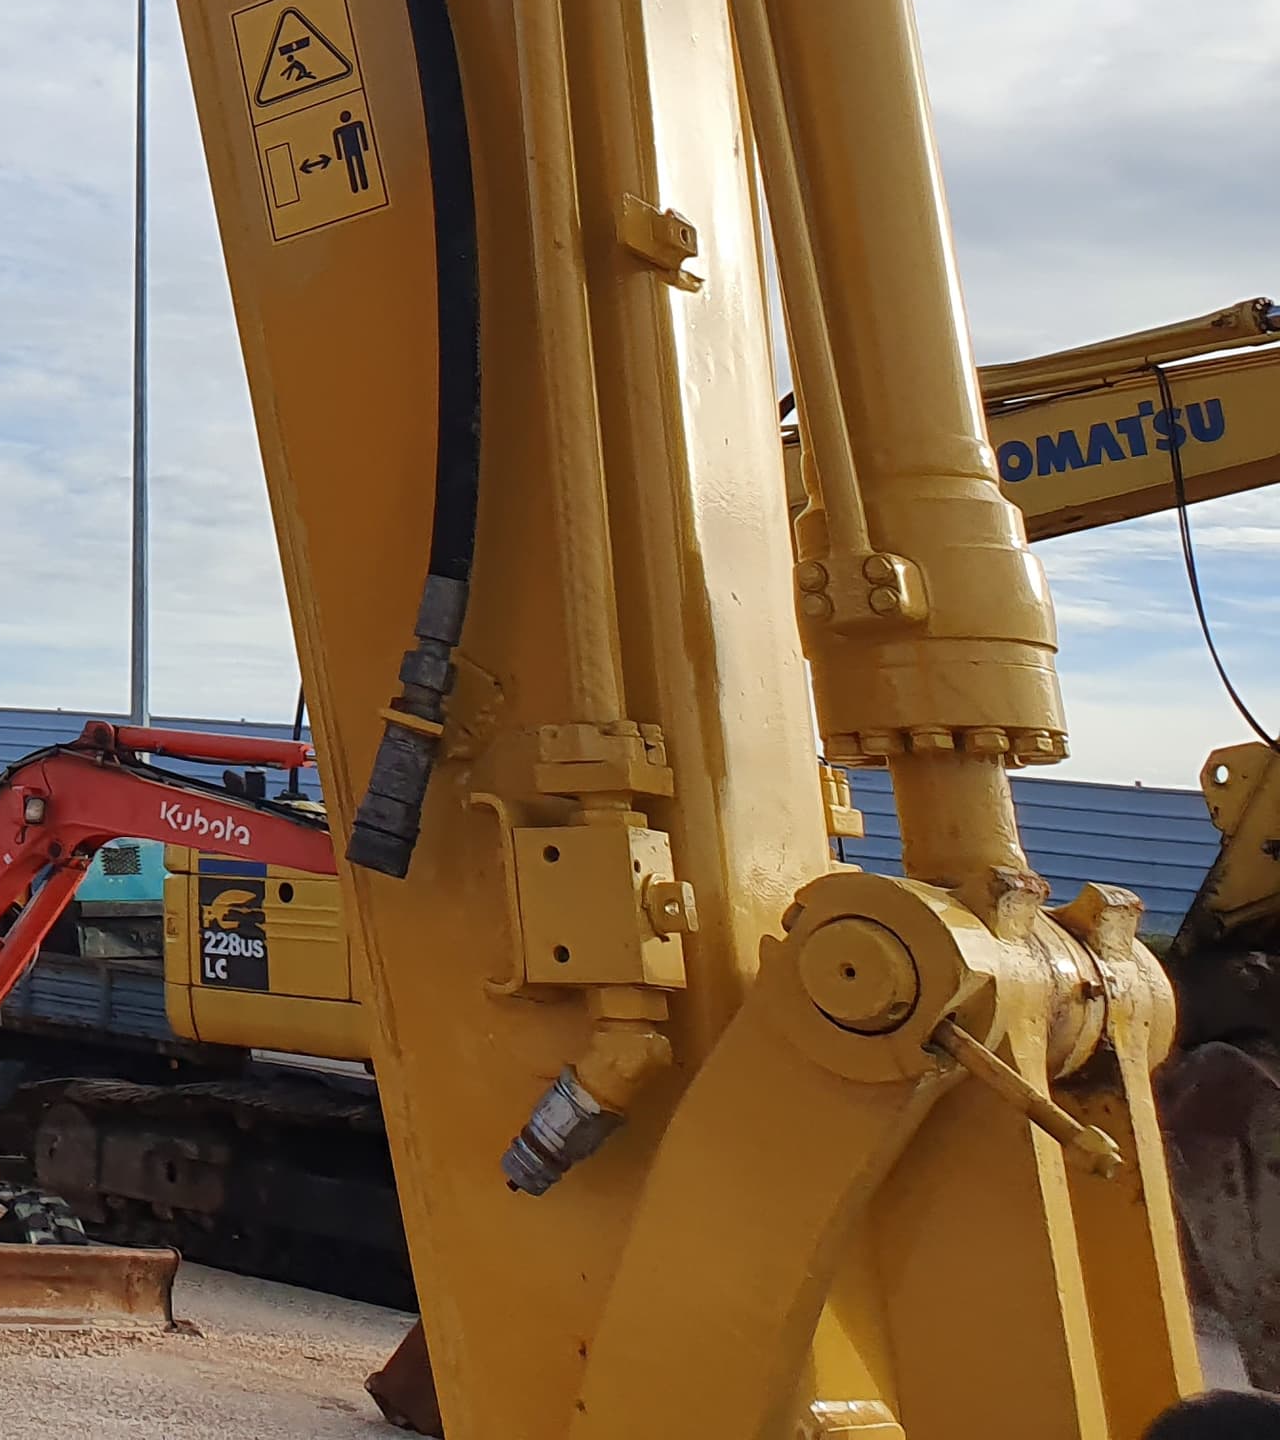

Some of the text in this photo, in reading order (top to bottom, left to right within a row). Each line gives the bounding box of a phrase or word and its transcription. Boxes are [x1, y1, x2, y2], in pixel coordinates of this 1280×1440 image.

[998, 400, 1225, 482] OMATSU
[160, 801, 250, 845] Kubota
[203, 931, 265, 958] 228US
[205, 958, 228, 979] LC
